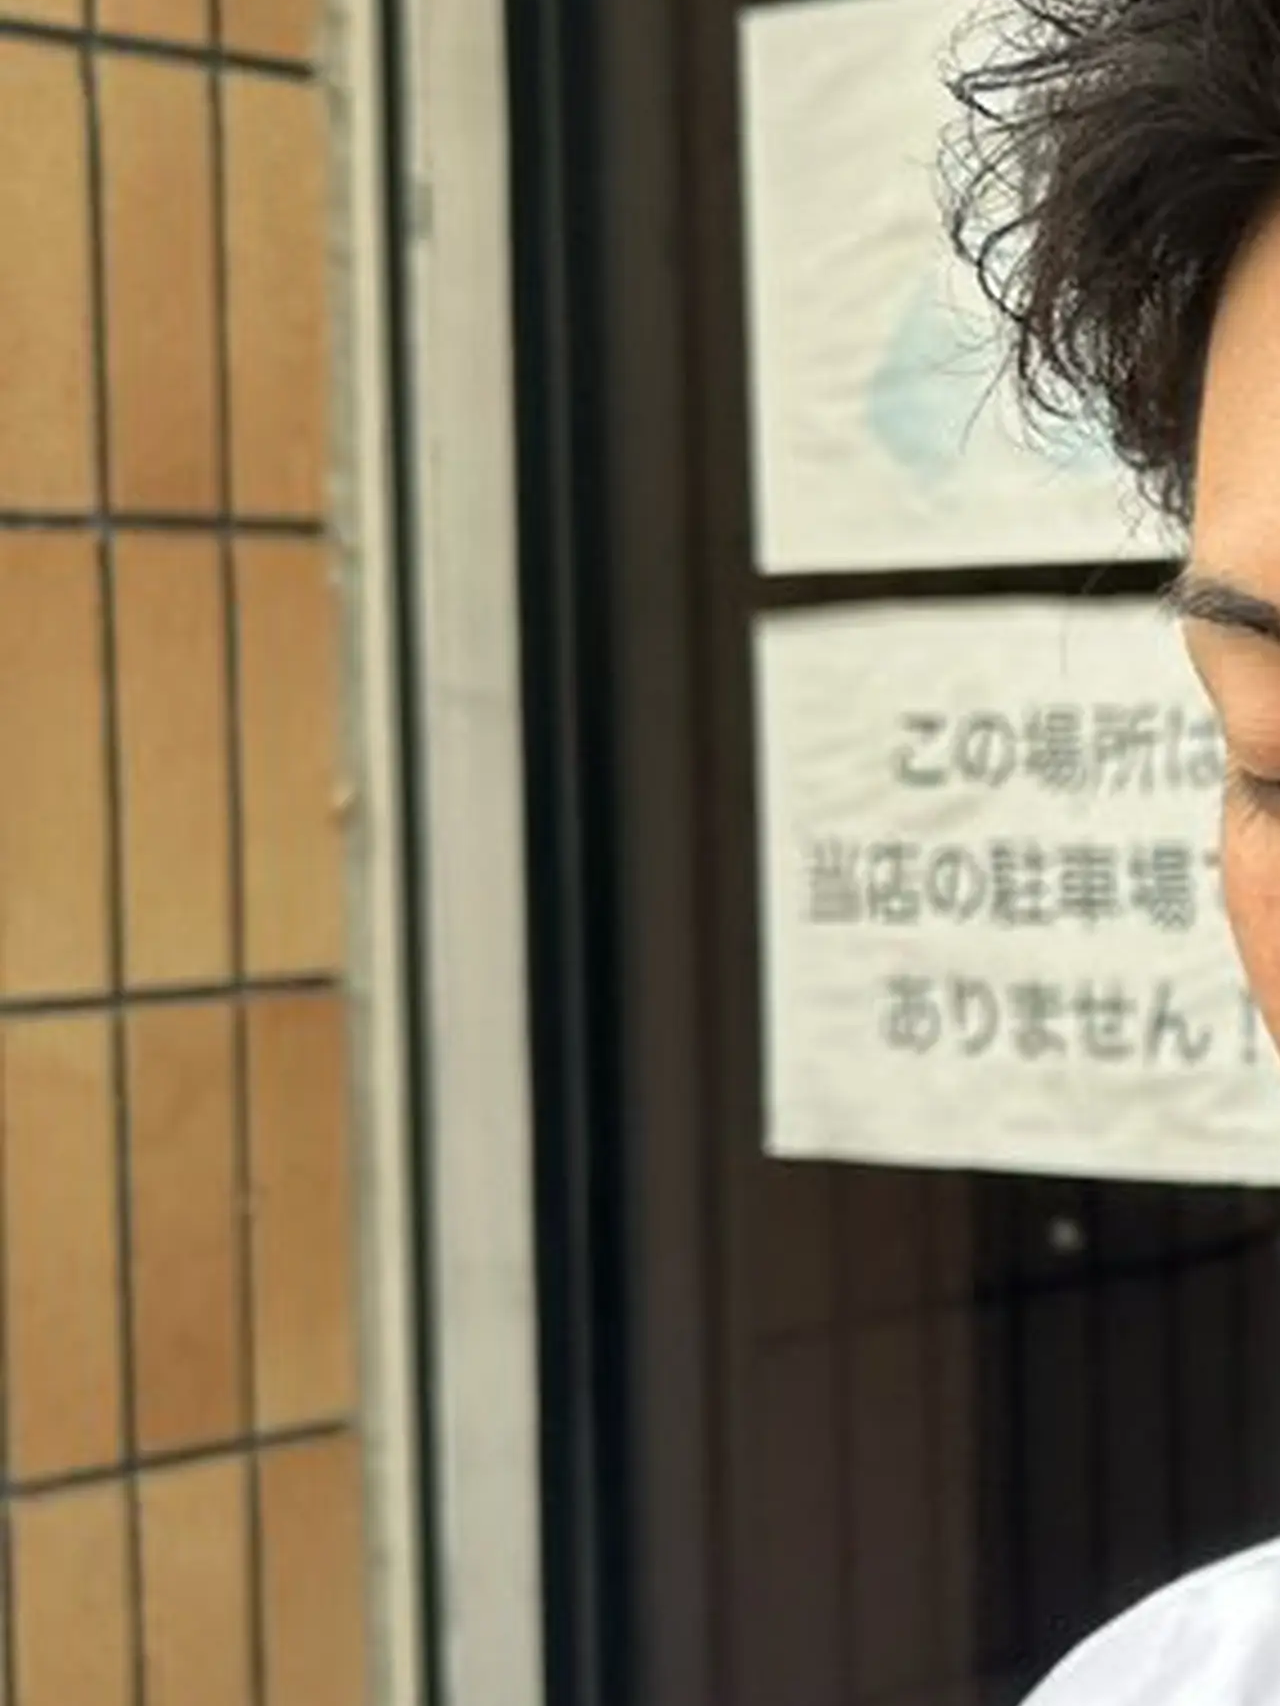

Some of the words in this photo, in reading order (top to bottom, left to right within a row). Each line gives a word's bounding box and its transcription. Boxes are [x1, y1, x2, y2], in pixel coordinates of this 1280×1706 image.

[893, 703, 1227, 793] この場所は
[806, 838, 1226, 933] 当店の駐車場
